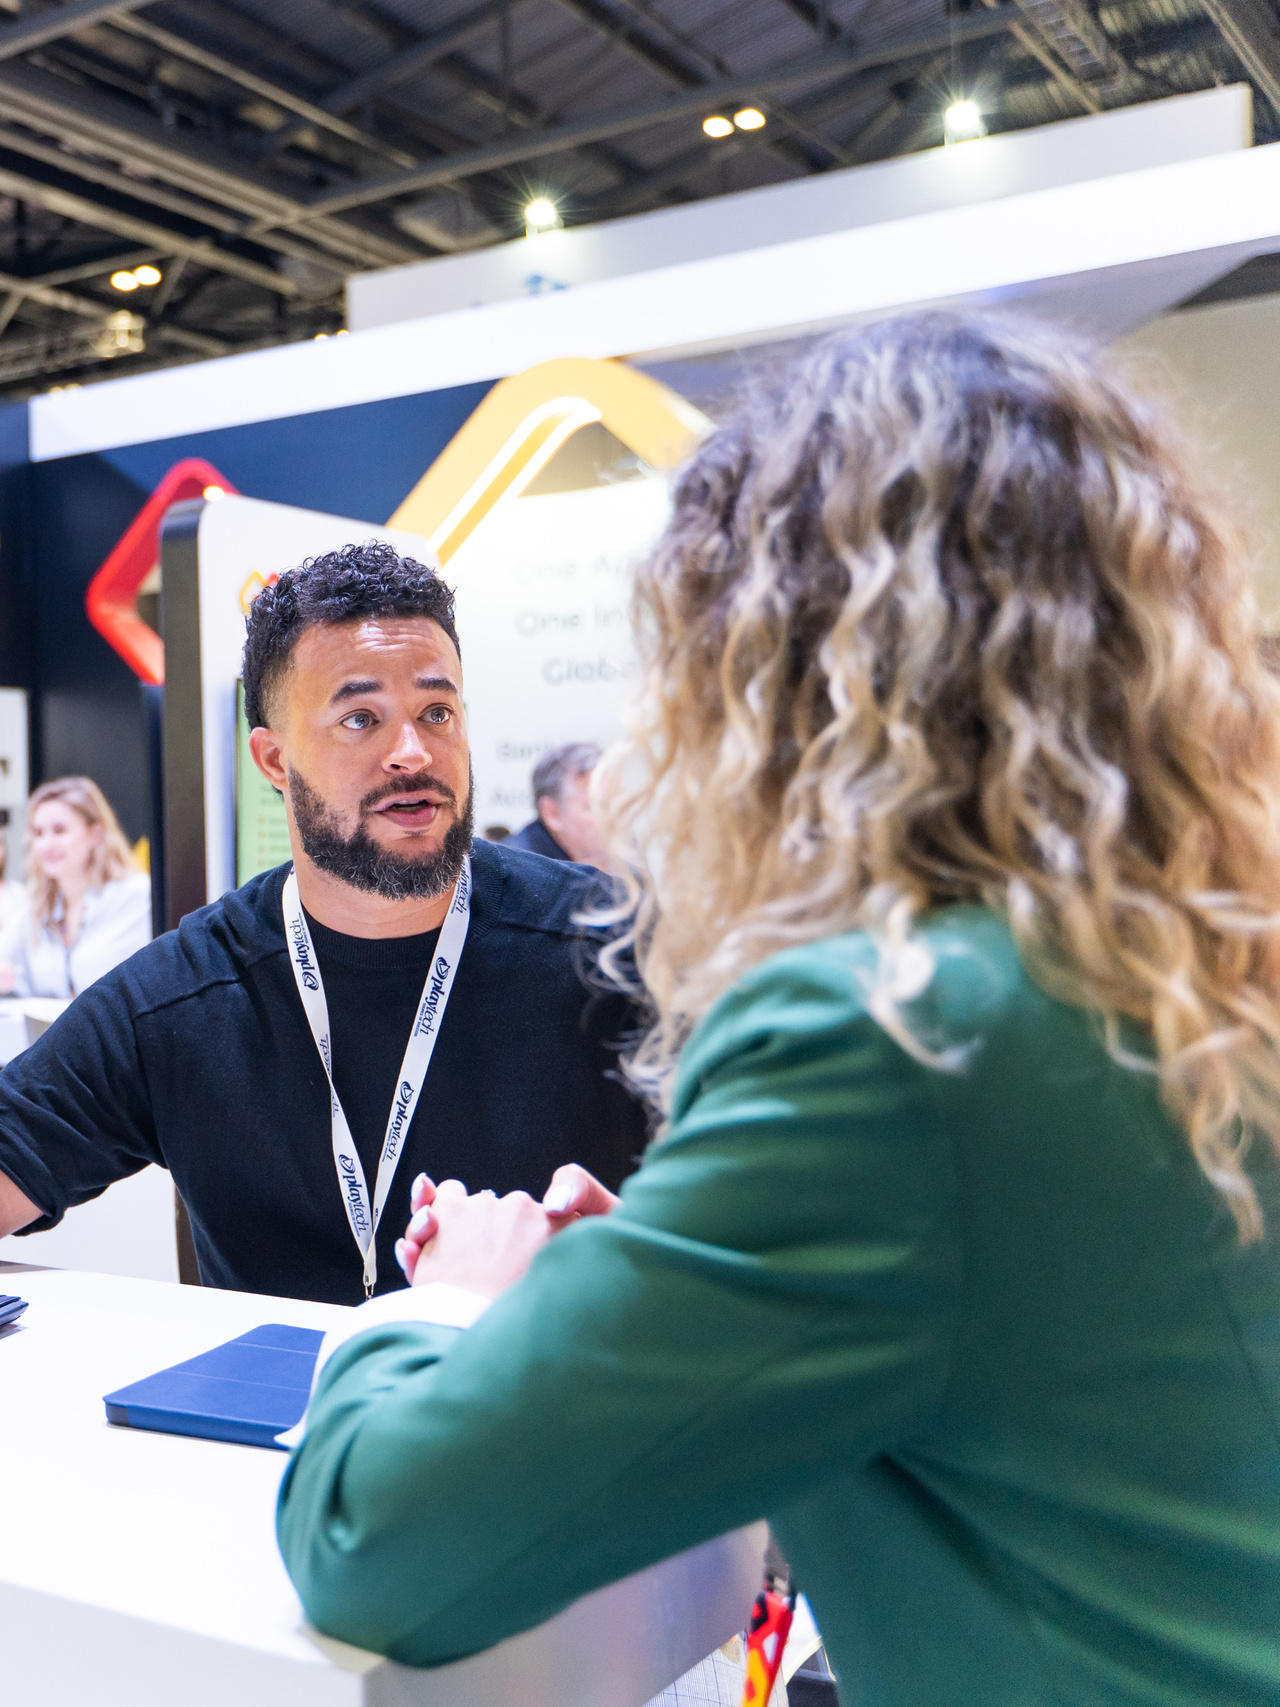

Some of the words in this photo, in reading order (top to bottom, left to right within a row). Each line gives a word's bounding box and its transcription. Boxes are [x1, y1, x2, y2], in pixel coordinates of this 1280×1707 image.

[289, 919, 315, 971] playtech
[420, 975, 445, 1035] playtech
[386, 1100, 408, 1160] playtech
[342, 1174, 369, 1231] playtech
